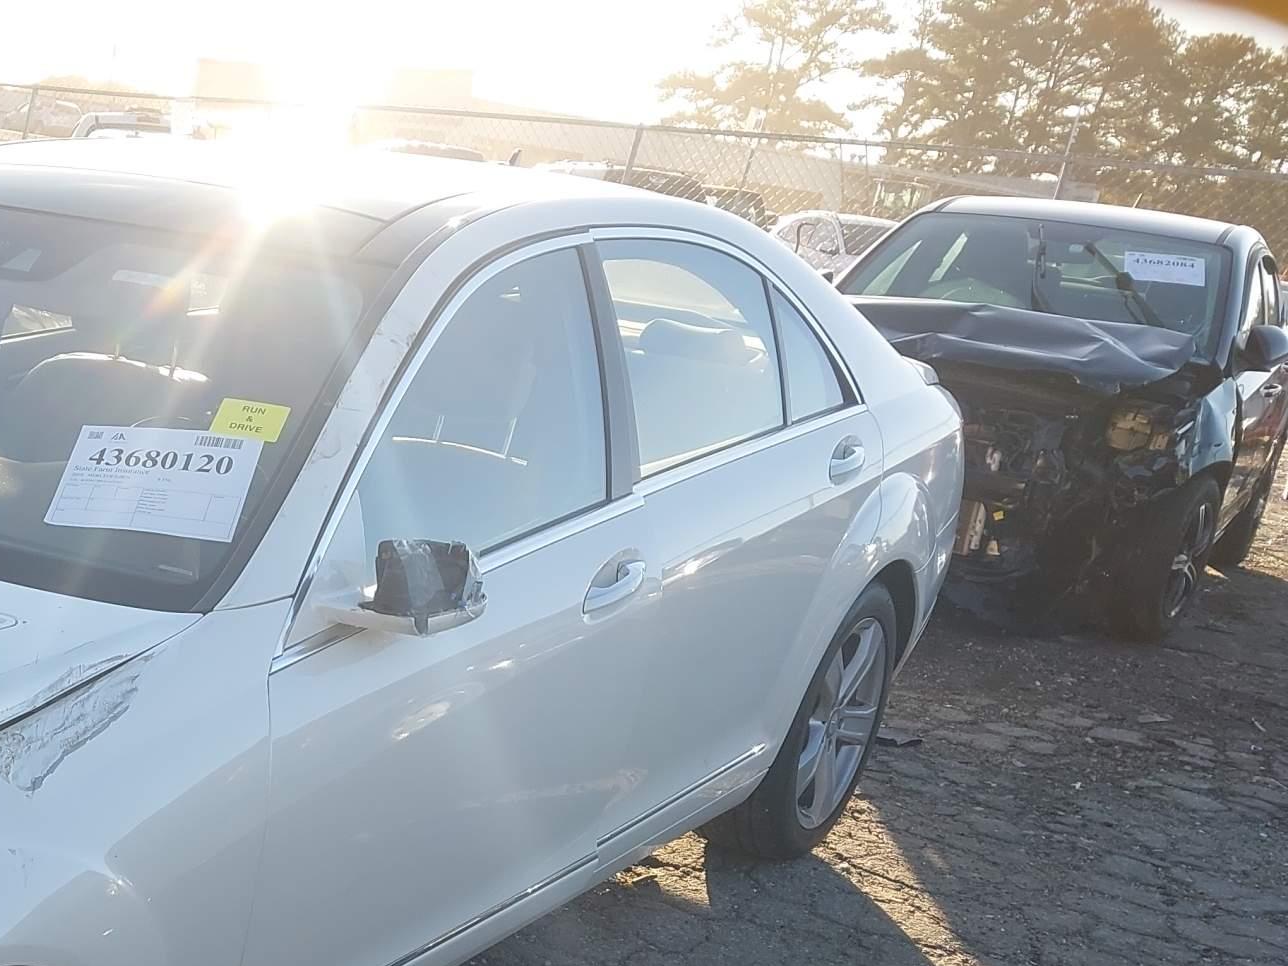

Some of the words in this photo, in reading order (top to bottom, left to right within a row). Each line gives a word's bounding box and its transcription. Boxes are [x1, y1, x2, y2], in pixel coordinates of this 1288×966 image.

[242, 405, 266, 415] RUN
[229, 422, 263, 433] DRIVE
[89, 447, 234, 475] 43680120
